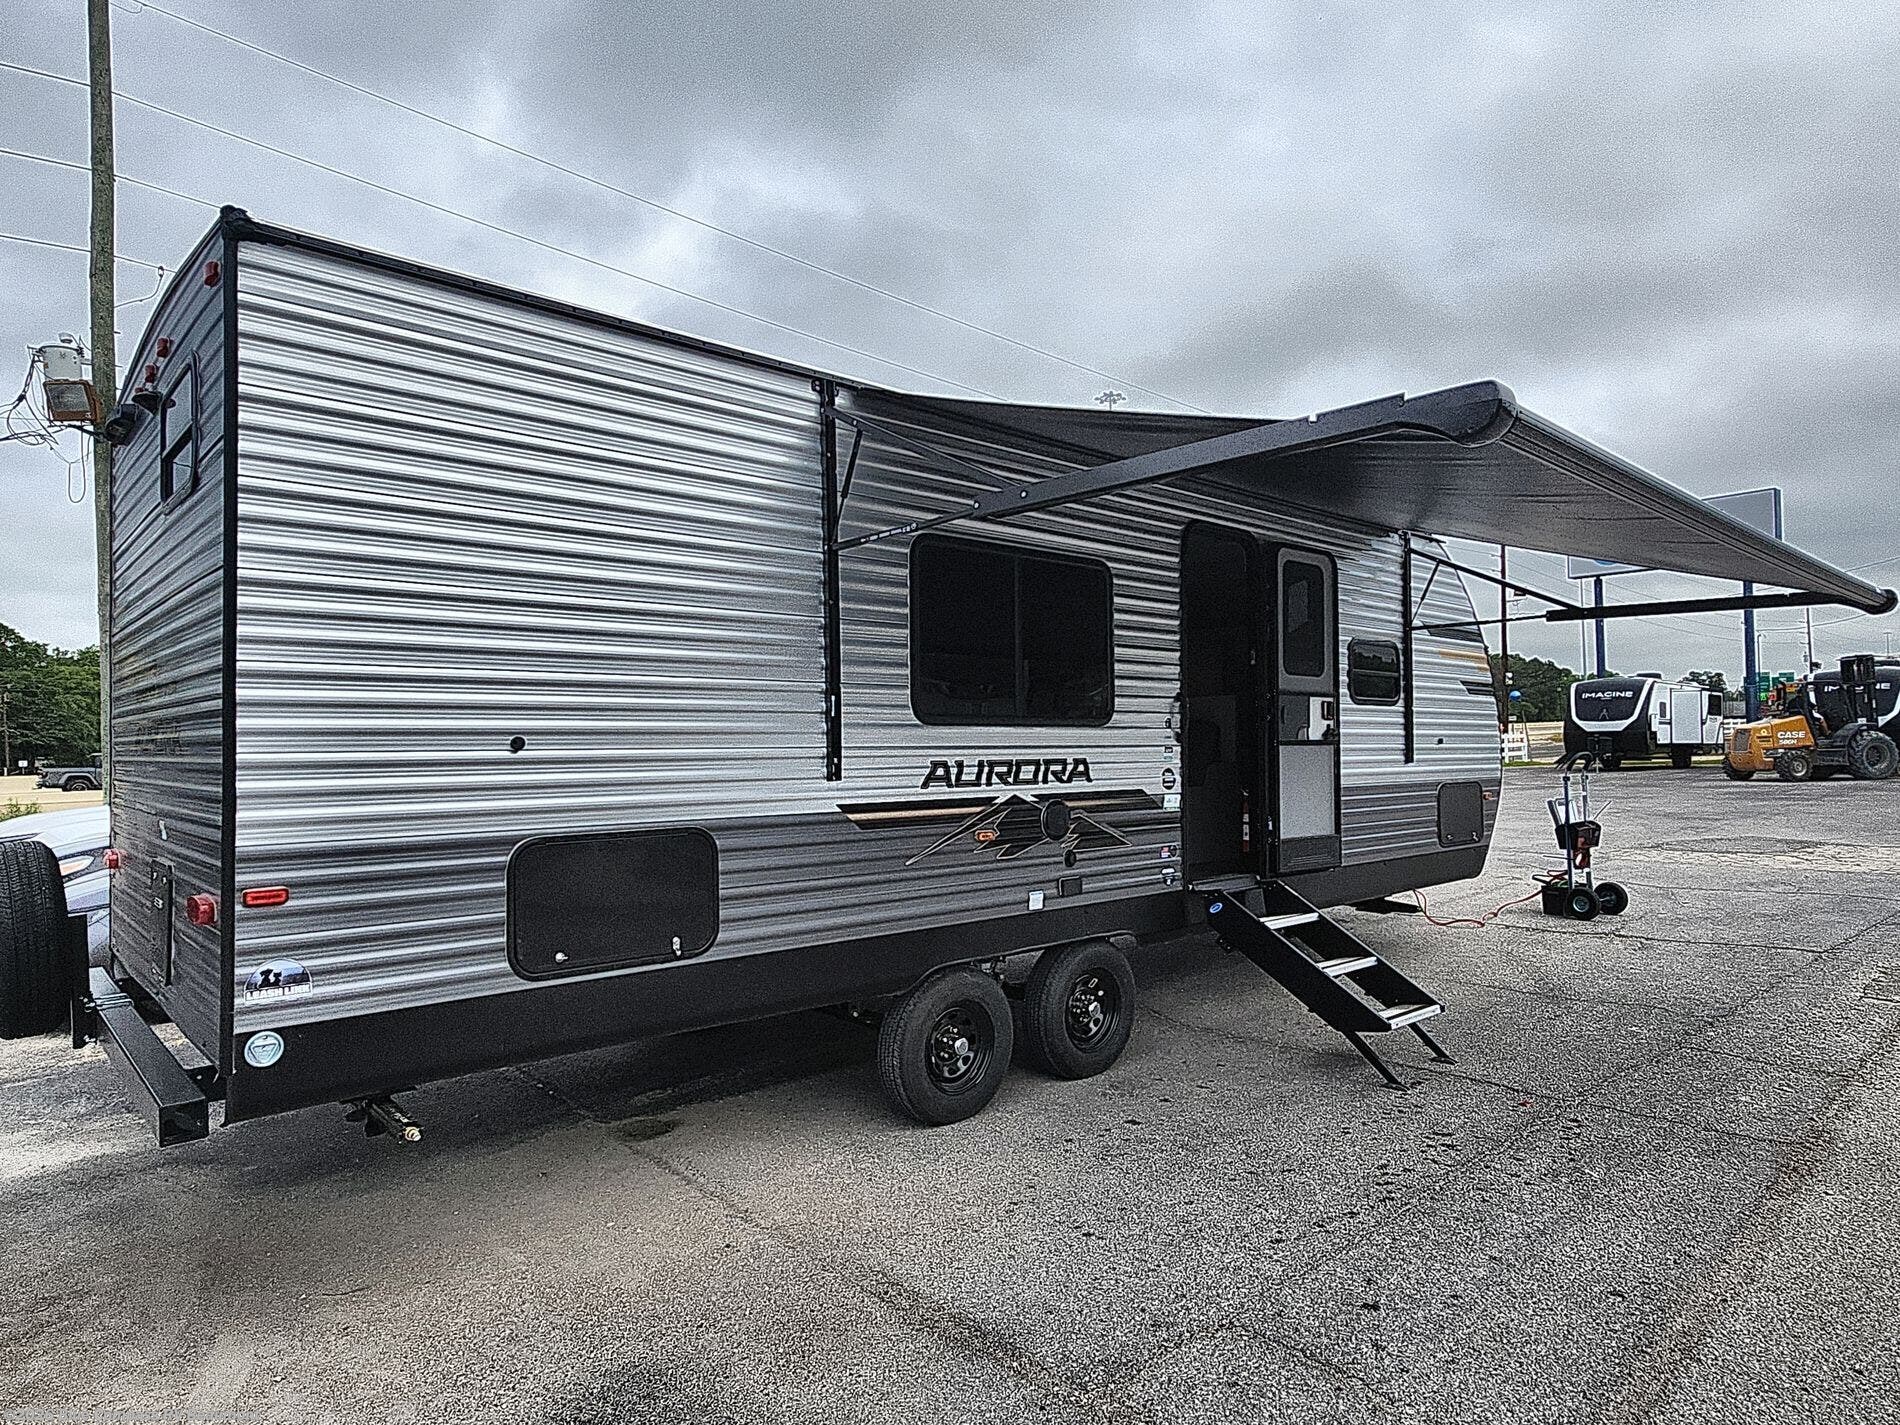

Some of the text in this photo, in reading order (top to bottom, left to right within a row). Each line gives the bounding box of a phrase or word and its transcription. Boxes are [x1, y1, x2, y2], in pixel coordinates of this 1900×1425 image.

[1582, 691, 1633, 699] IMAGINE
[1777, 731, 1806, 739] CASE
[920, 758, 1093, 789] AURORA
[246, 987, 283, 1001] LEASH
